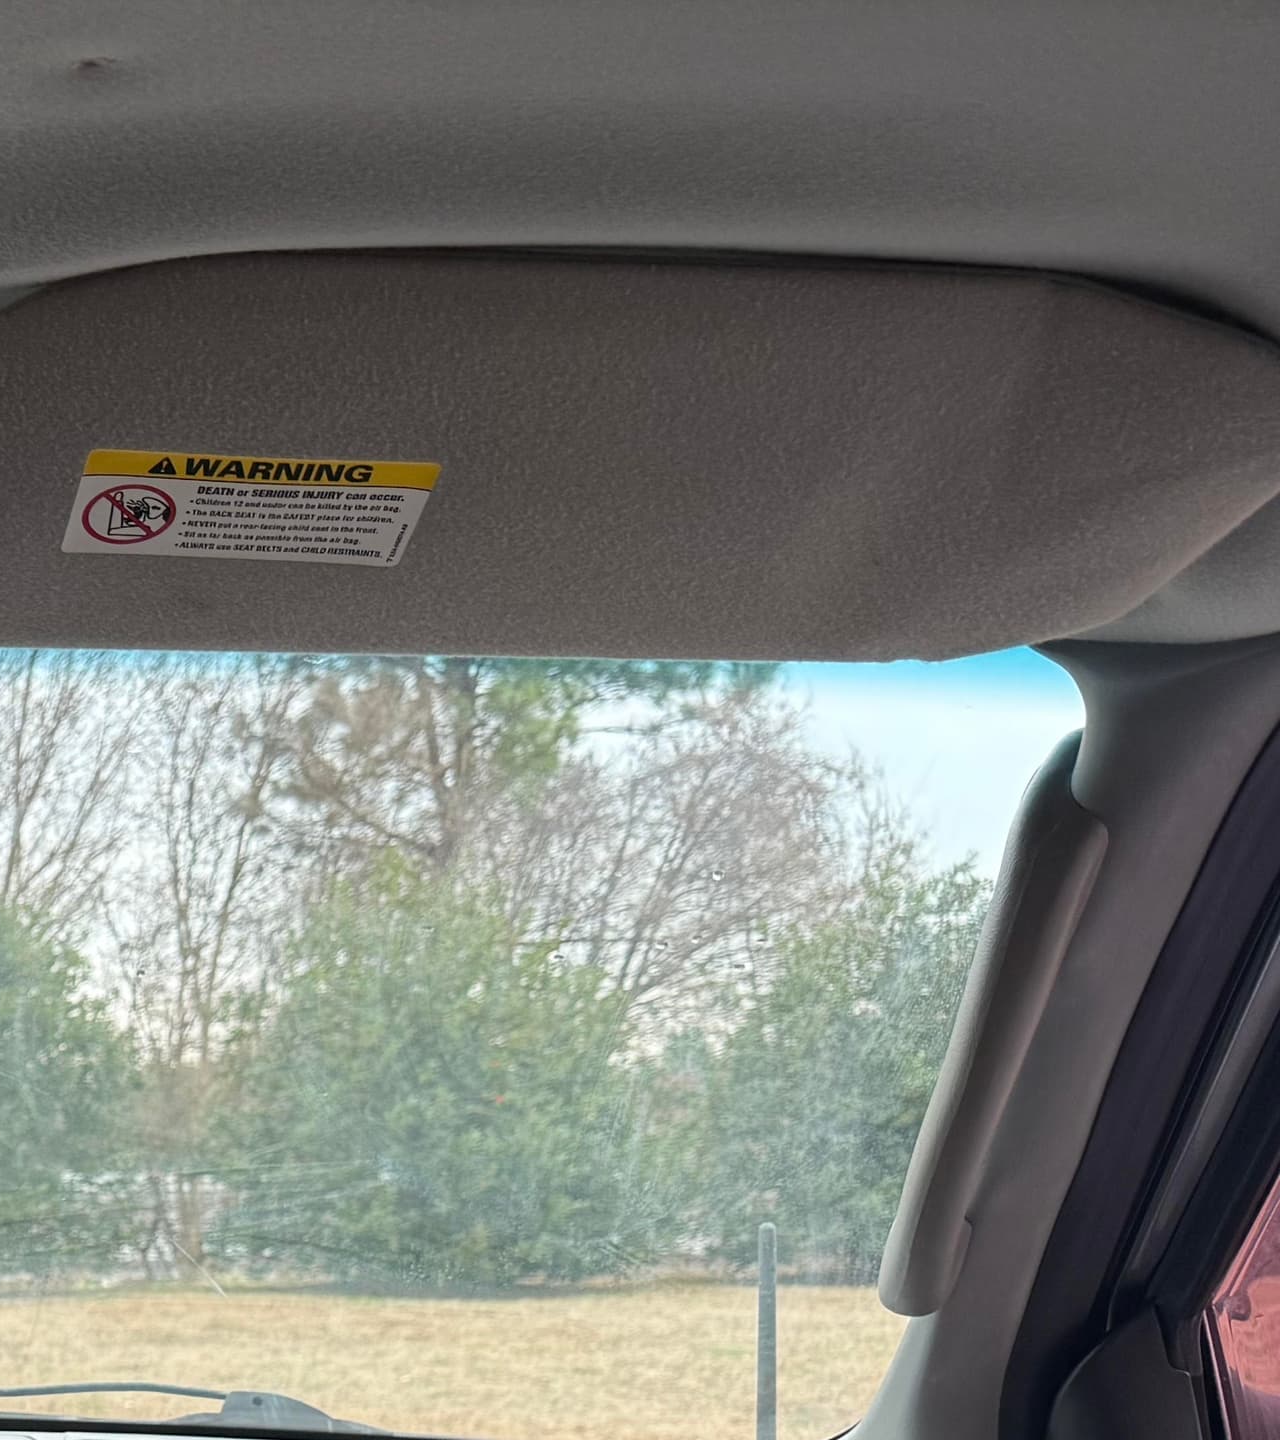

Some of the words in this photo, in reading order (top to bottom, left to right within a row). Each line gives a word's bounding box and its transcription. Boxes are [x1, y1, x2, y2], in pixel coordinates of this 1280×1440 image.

[185, 457, 374, 483] WARNING
[197, 486, 235, 496] DEATH
[236, 489, 249, 497] or
[251, 489, 300, 499] SERIOUS
[302, 490, 344, 500] INJURY
[345, 493, 367, 501] can
[369, 494, 405, 502] occur.
[195, 498, 231, 506] Children
[317, 503, 341, 511] killed
[343, 504, 352, 512] by
[188, 520, 217, 528] NEVER
[179, 542, 215, 550] ALWAYS
